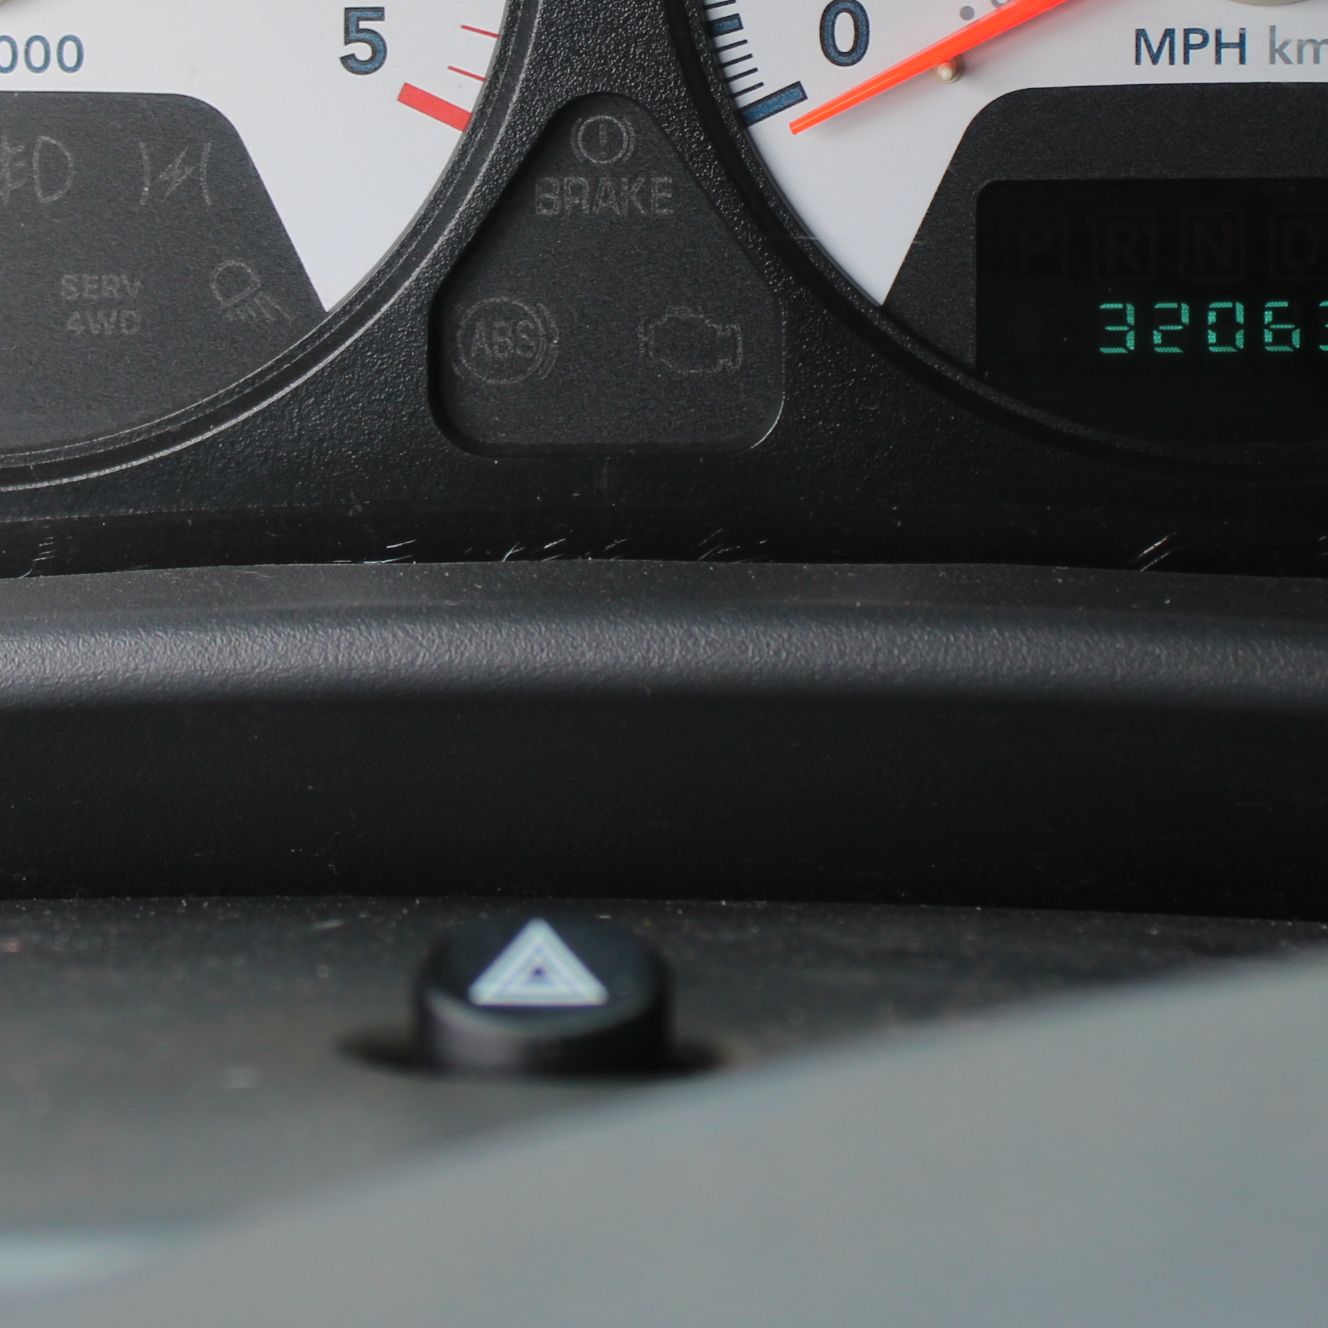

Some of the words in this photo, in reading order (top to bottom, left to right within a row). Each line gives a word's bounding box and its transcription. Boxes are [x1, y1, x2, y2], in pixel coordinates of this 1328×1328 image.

[339, 6, 390, 75] 5
[1134, 27, 1248, 66] MPH
[534, 176, 674, 217] BRAKE
[471, 320, 536, 358] ABS
